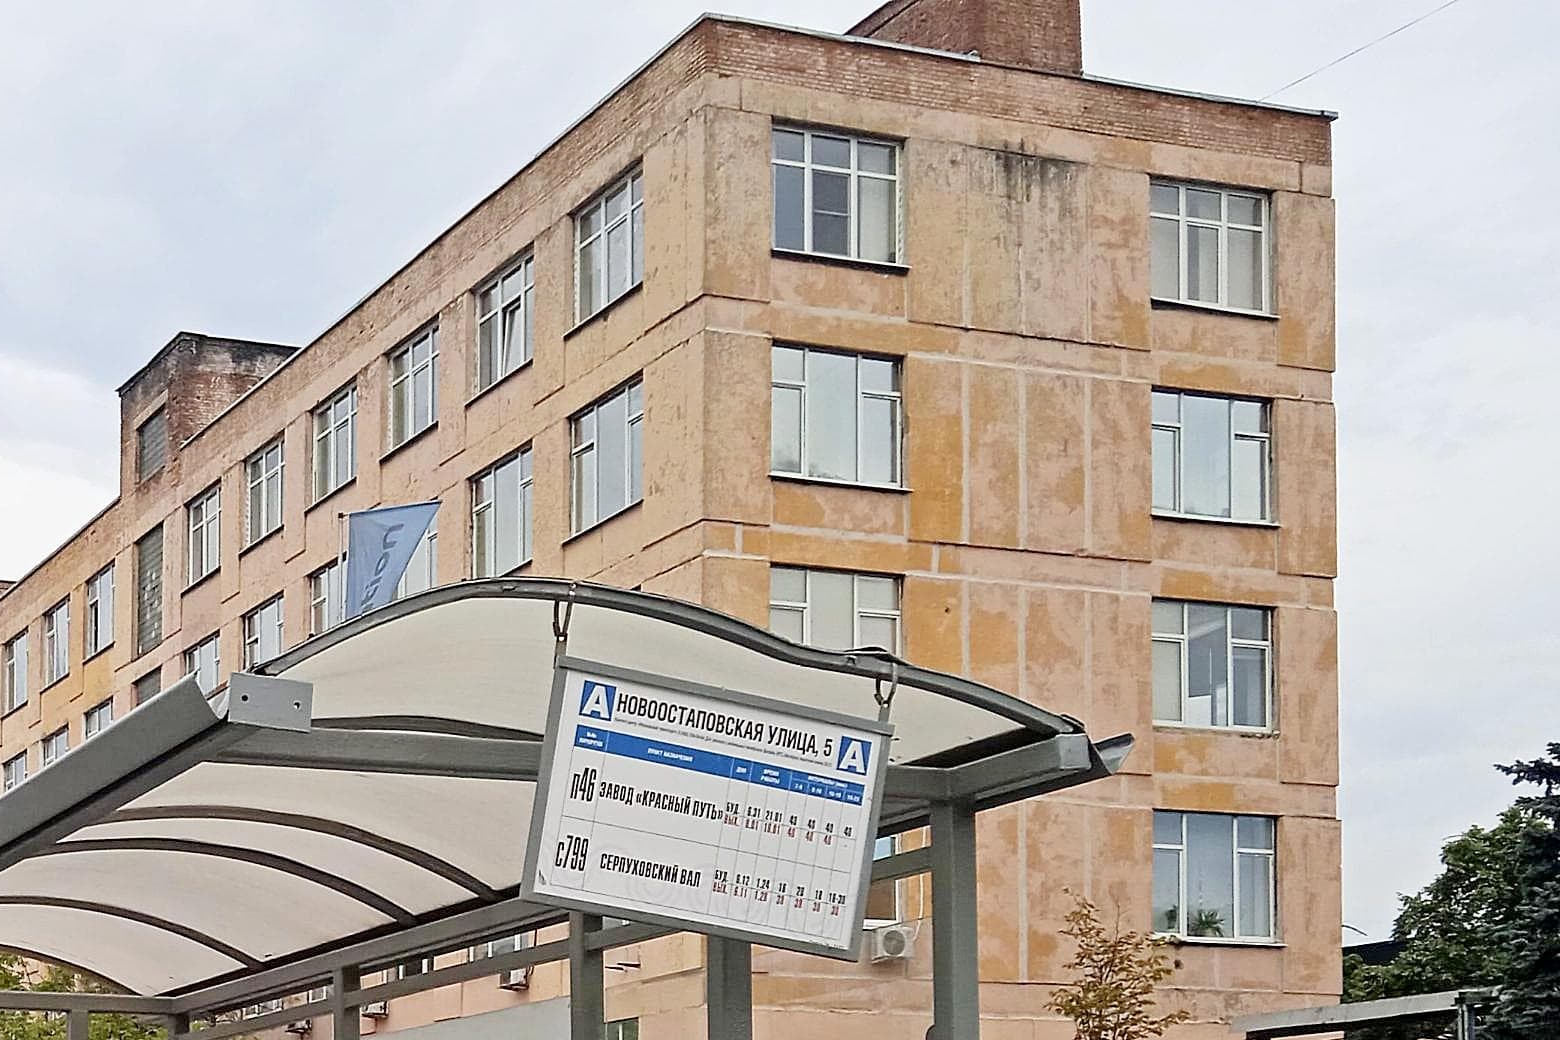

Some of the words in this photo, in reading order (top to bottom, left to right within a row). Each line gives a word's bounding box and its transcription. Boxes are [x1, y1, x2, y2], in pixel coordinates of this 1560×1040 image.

[581, 684, 610, 719] А
[616, 692, 764, 743] НОВООСТАПОВСКАЯ
[767, 725, 819, 757] УЛИЦА,
[823, 738, 833, 757] 5
[839, 740, 866, 774] А
[570, 767, 597, 802] п46
[599, 781, 635, 806] ЗАВОД
[636, 789, 691, 815] «КРАСНЫЙ
[691, 799, 723, 821] ПУТЬ»
[555, 835, 589, 872] с799
[600, 853, 679, 884] СЕРПУХОВСКИЙ
[679, 869, 702, 888] ВАЛ
